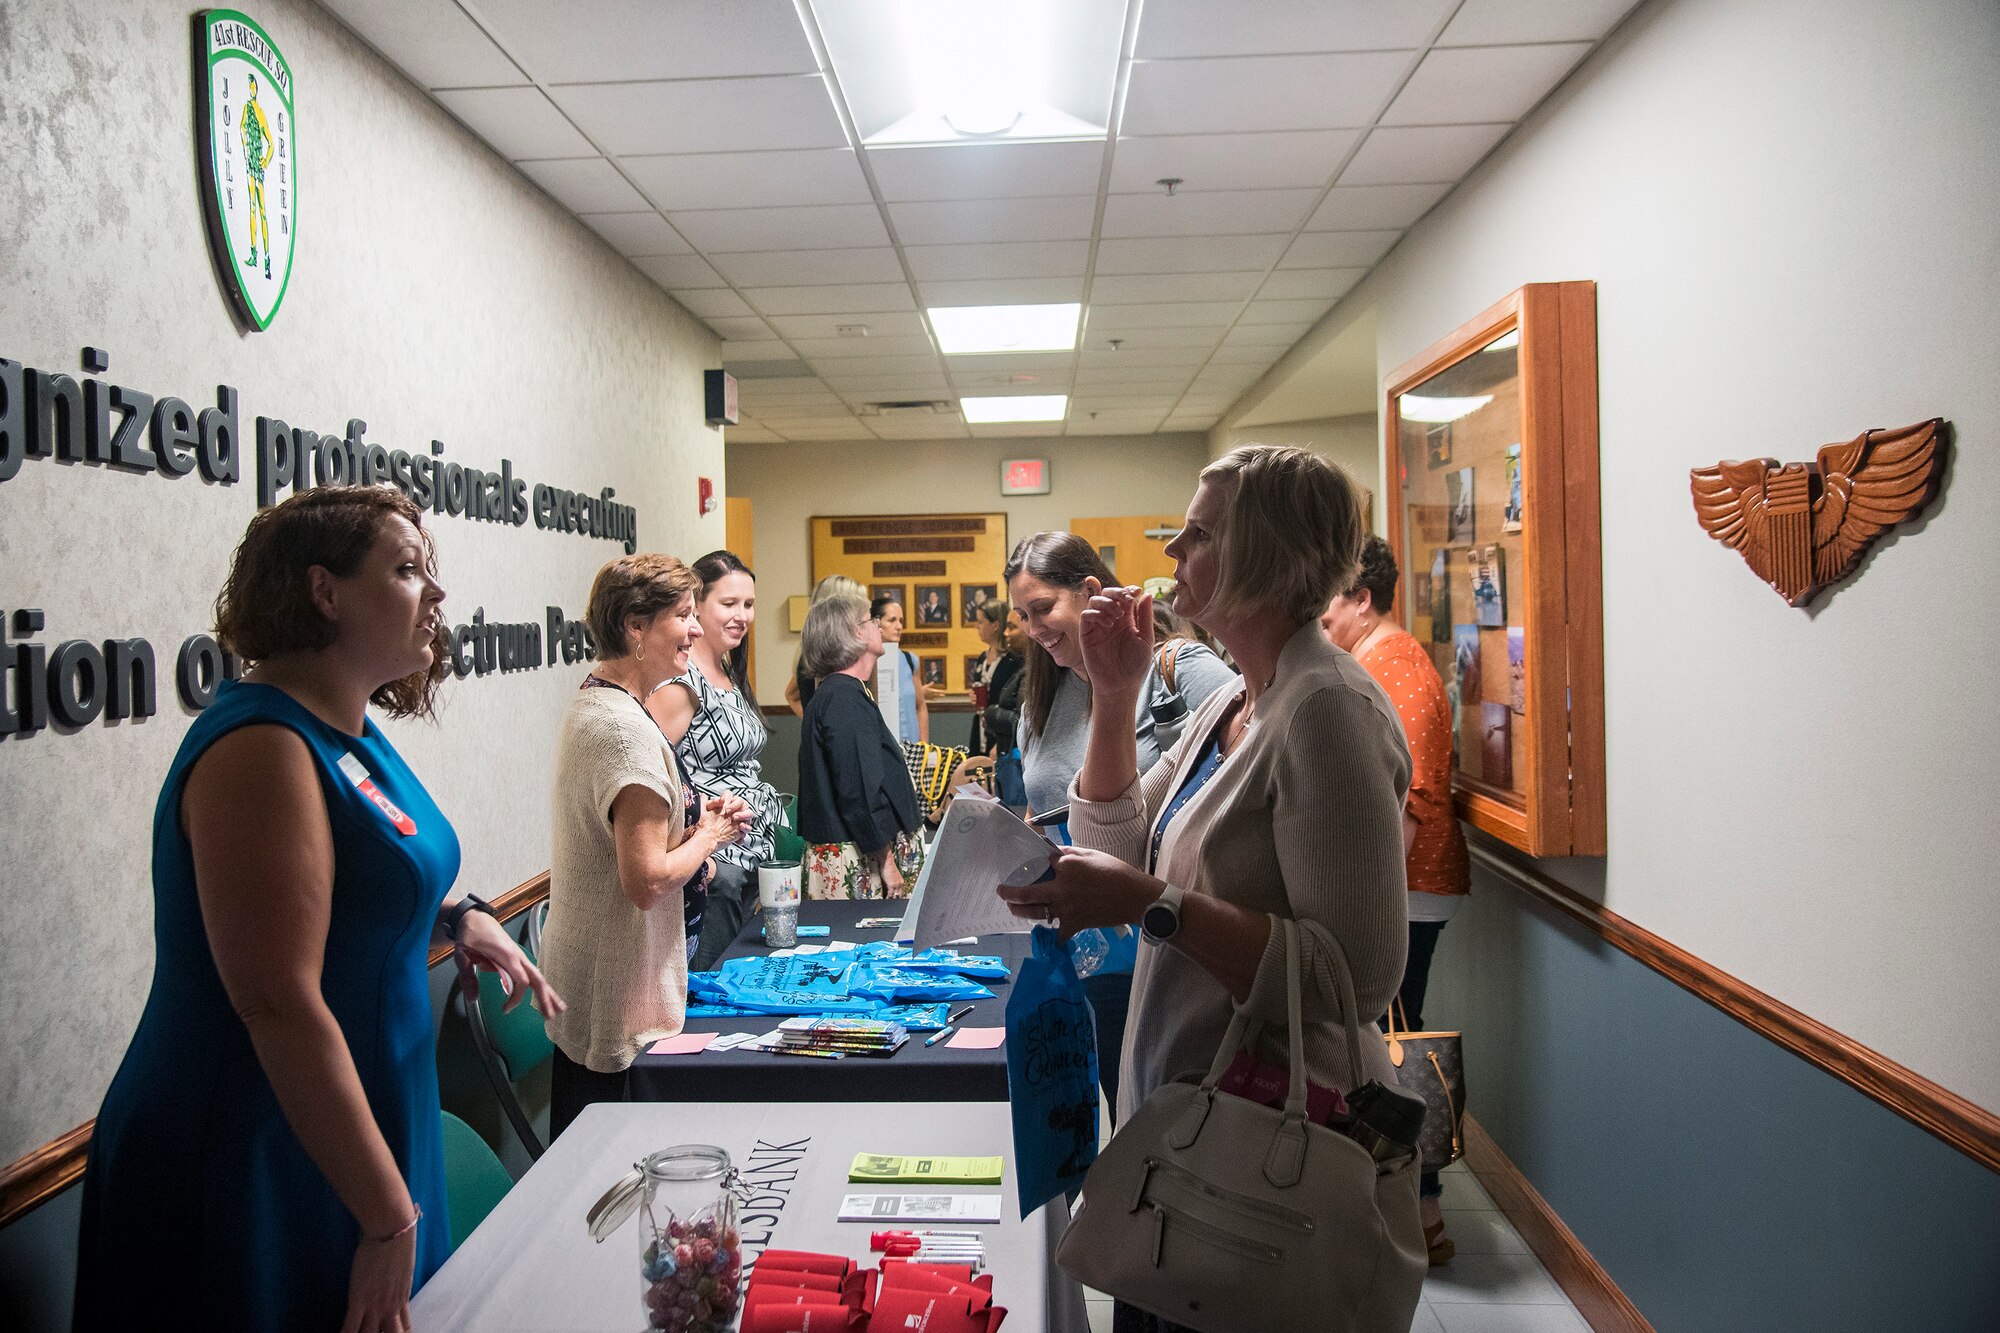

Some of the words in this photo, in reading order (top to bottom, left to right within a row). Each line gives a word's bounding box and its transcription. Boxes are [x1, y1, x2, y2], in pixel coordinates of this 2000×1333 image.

[214, 23, 236, 47] 41st
[235, 24, 273, 71] RESCUE
[274, 61, 288, 93] SQ
[256, 416, 528, 527] professionals
[533, 483, 637, 555] executing
